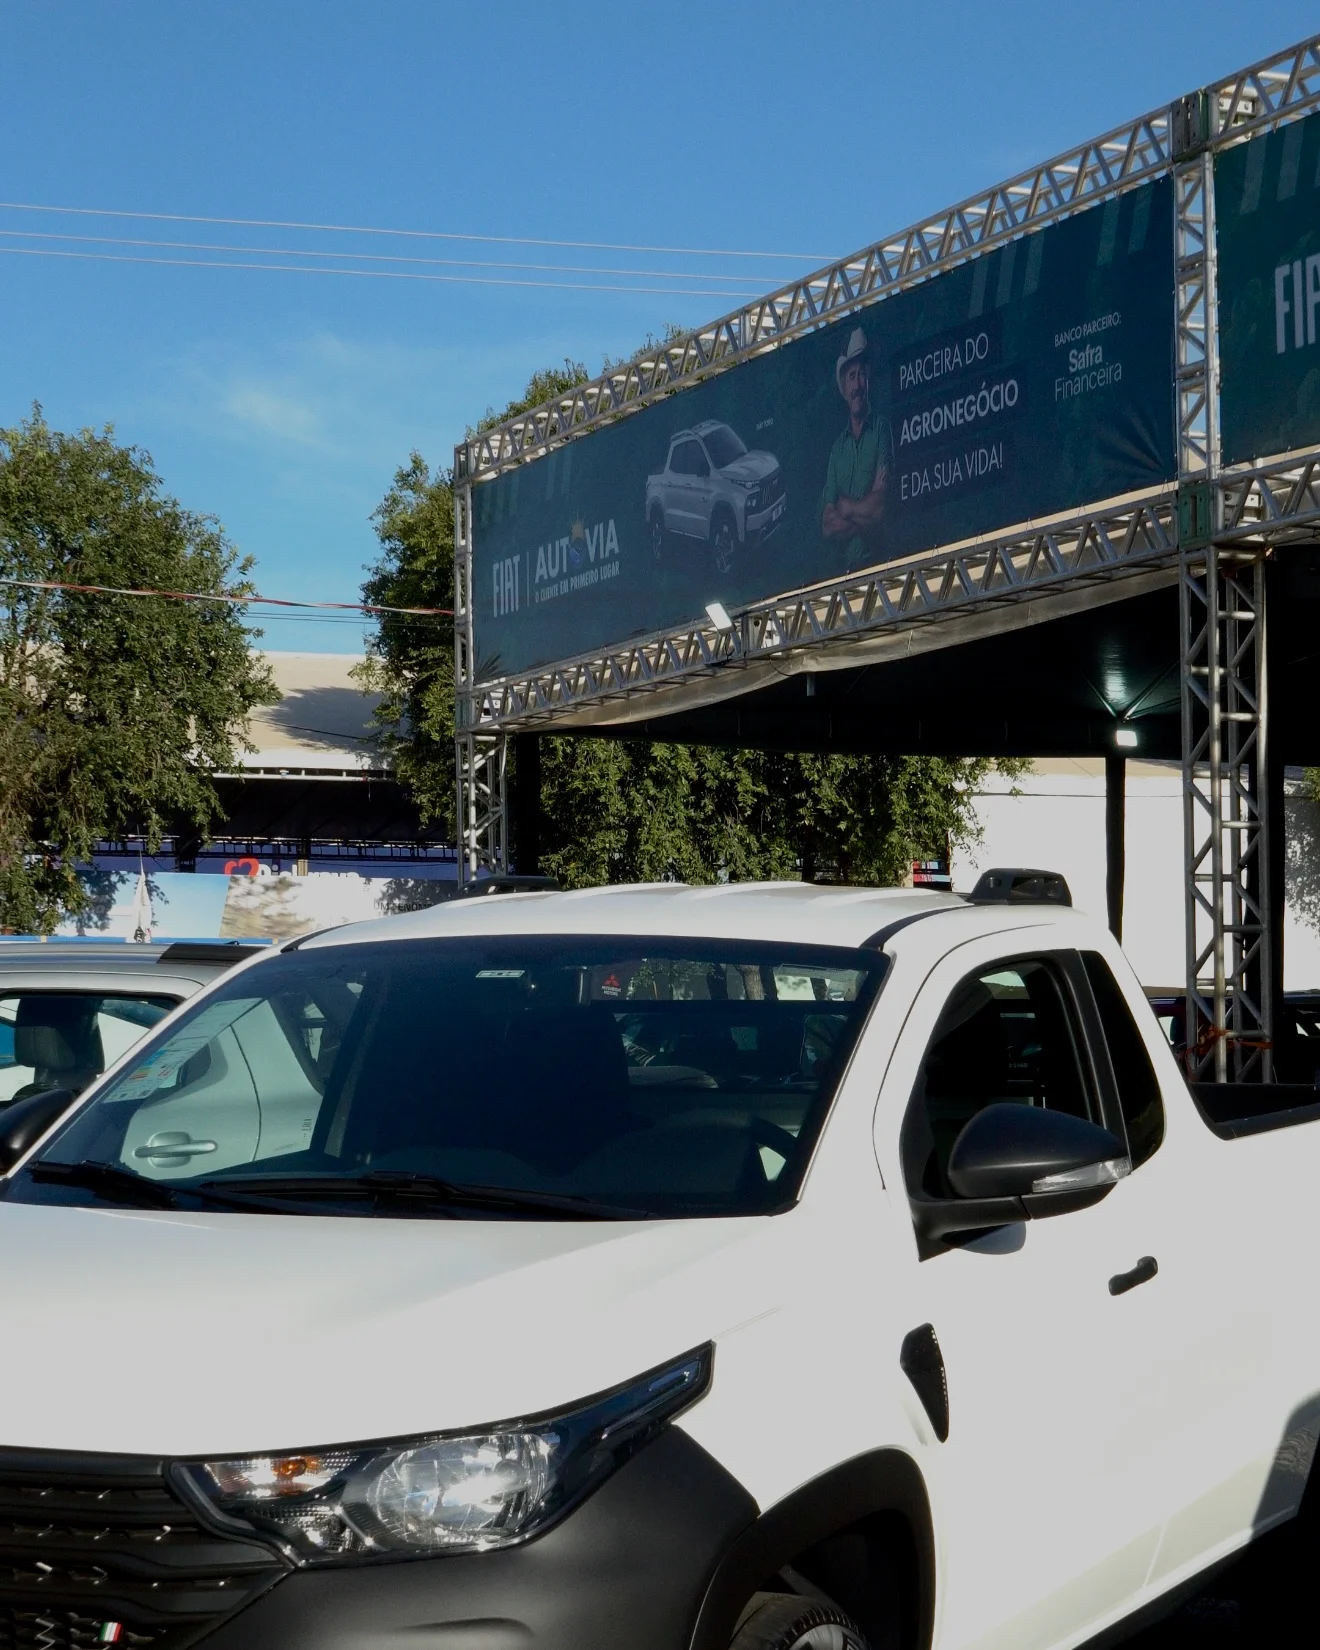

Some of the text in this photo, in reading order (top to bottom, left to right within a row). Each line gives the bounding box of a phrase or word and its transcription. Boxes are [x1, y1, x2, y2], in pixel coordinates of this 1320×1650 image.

[1055, 312, 1122, 347] BANCO PARCEIRO:
[901, 332, 989, 390] PARCEIRA DO
[1069, 344, 1103, 374] Safra
[1055, 362, 1122, 401] Financeira
[900, 379, 1019, 446] AGRONEGÓCIO
[901, 442, 1003, 500] E DA SUA VIDA!
[493, 554, 521, 618] FIAT
[560, 579, 569, 595] EM
[570, 568, 599, 591] PRIMEIRO
[600, 561, 620, 581] LUGAR
[373, 901, 389, 911] UM
